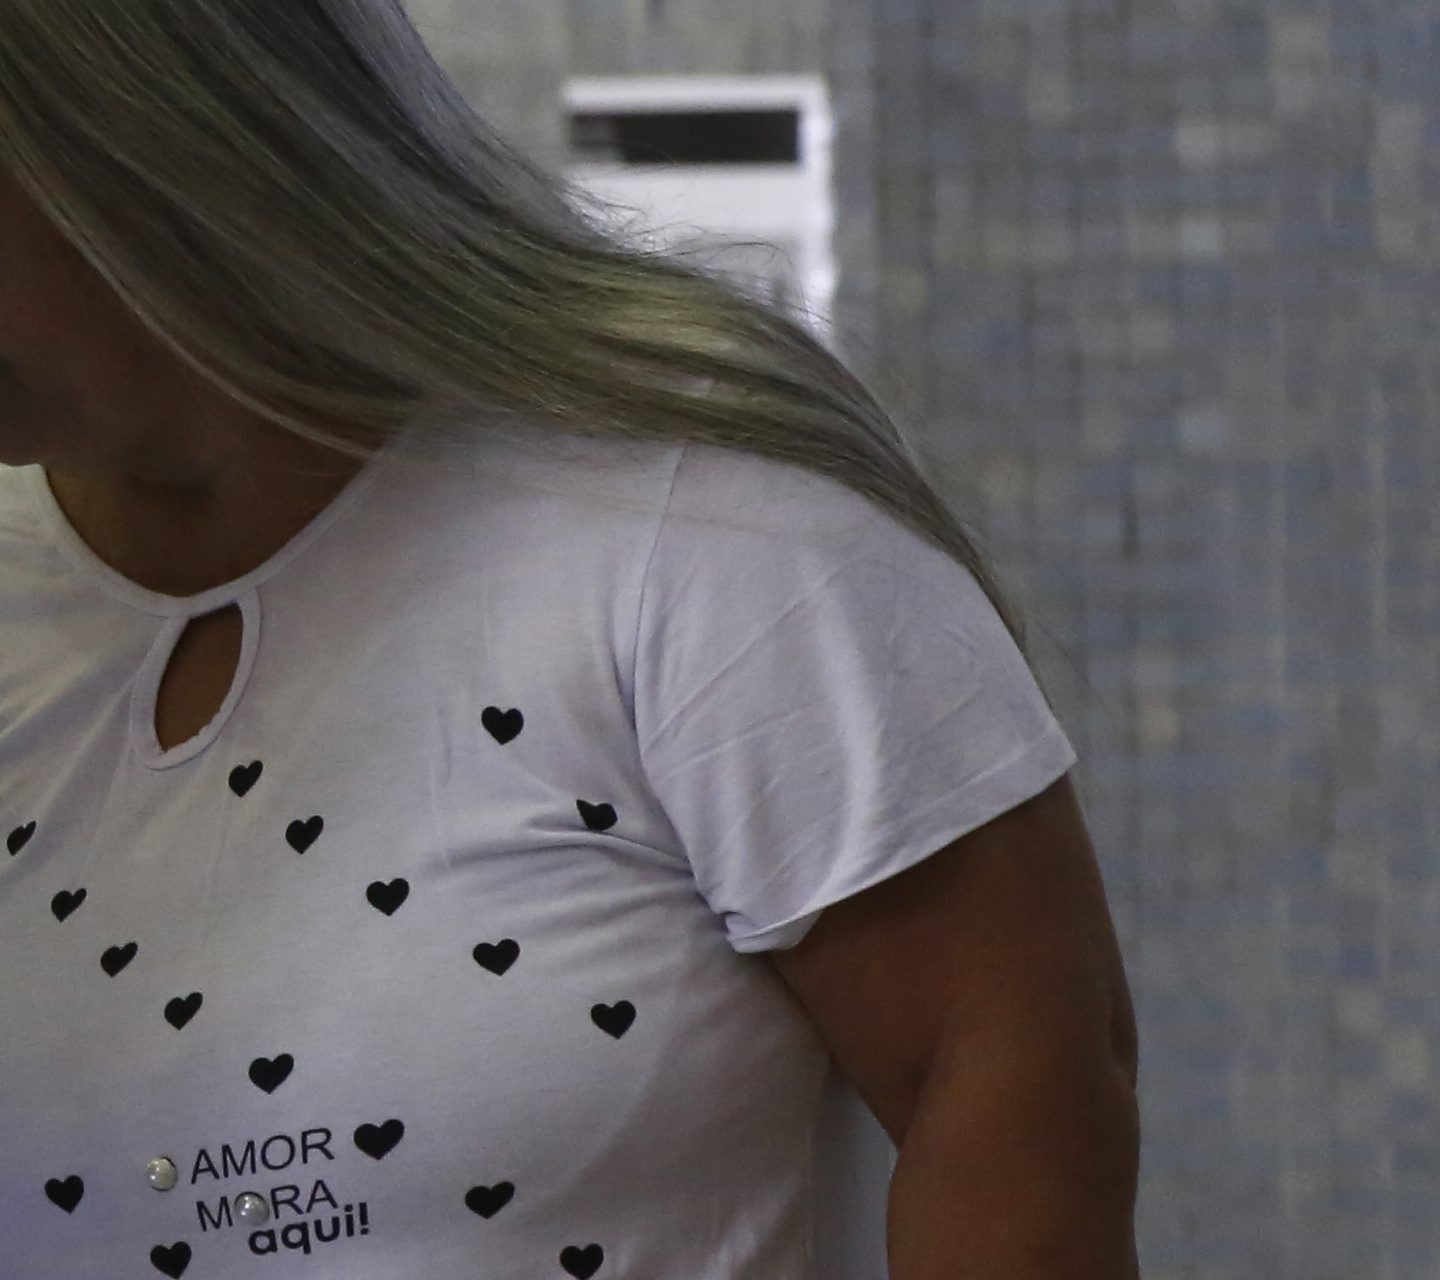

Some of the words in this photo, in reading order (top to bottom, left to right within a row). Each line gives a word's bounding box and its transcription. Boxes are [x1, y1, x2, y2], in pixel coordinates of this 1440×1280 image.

[191, 1127, 335, 1184] AMOR
[196, 1179, 339, 1232] MRA
[248, 1202, 370, 1255] aqui!
